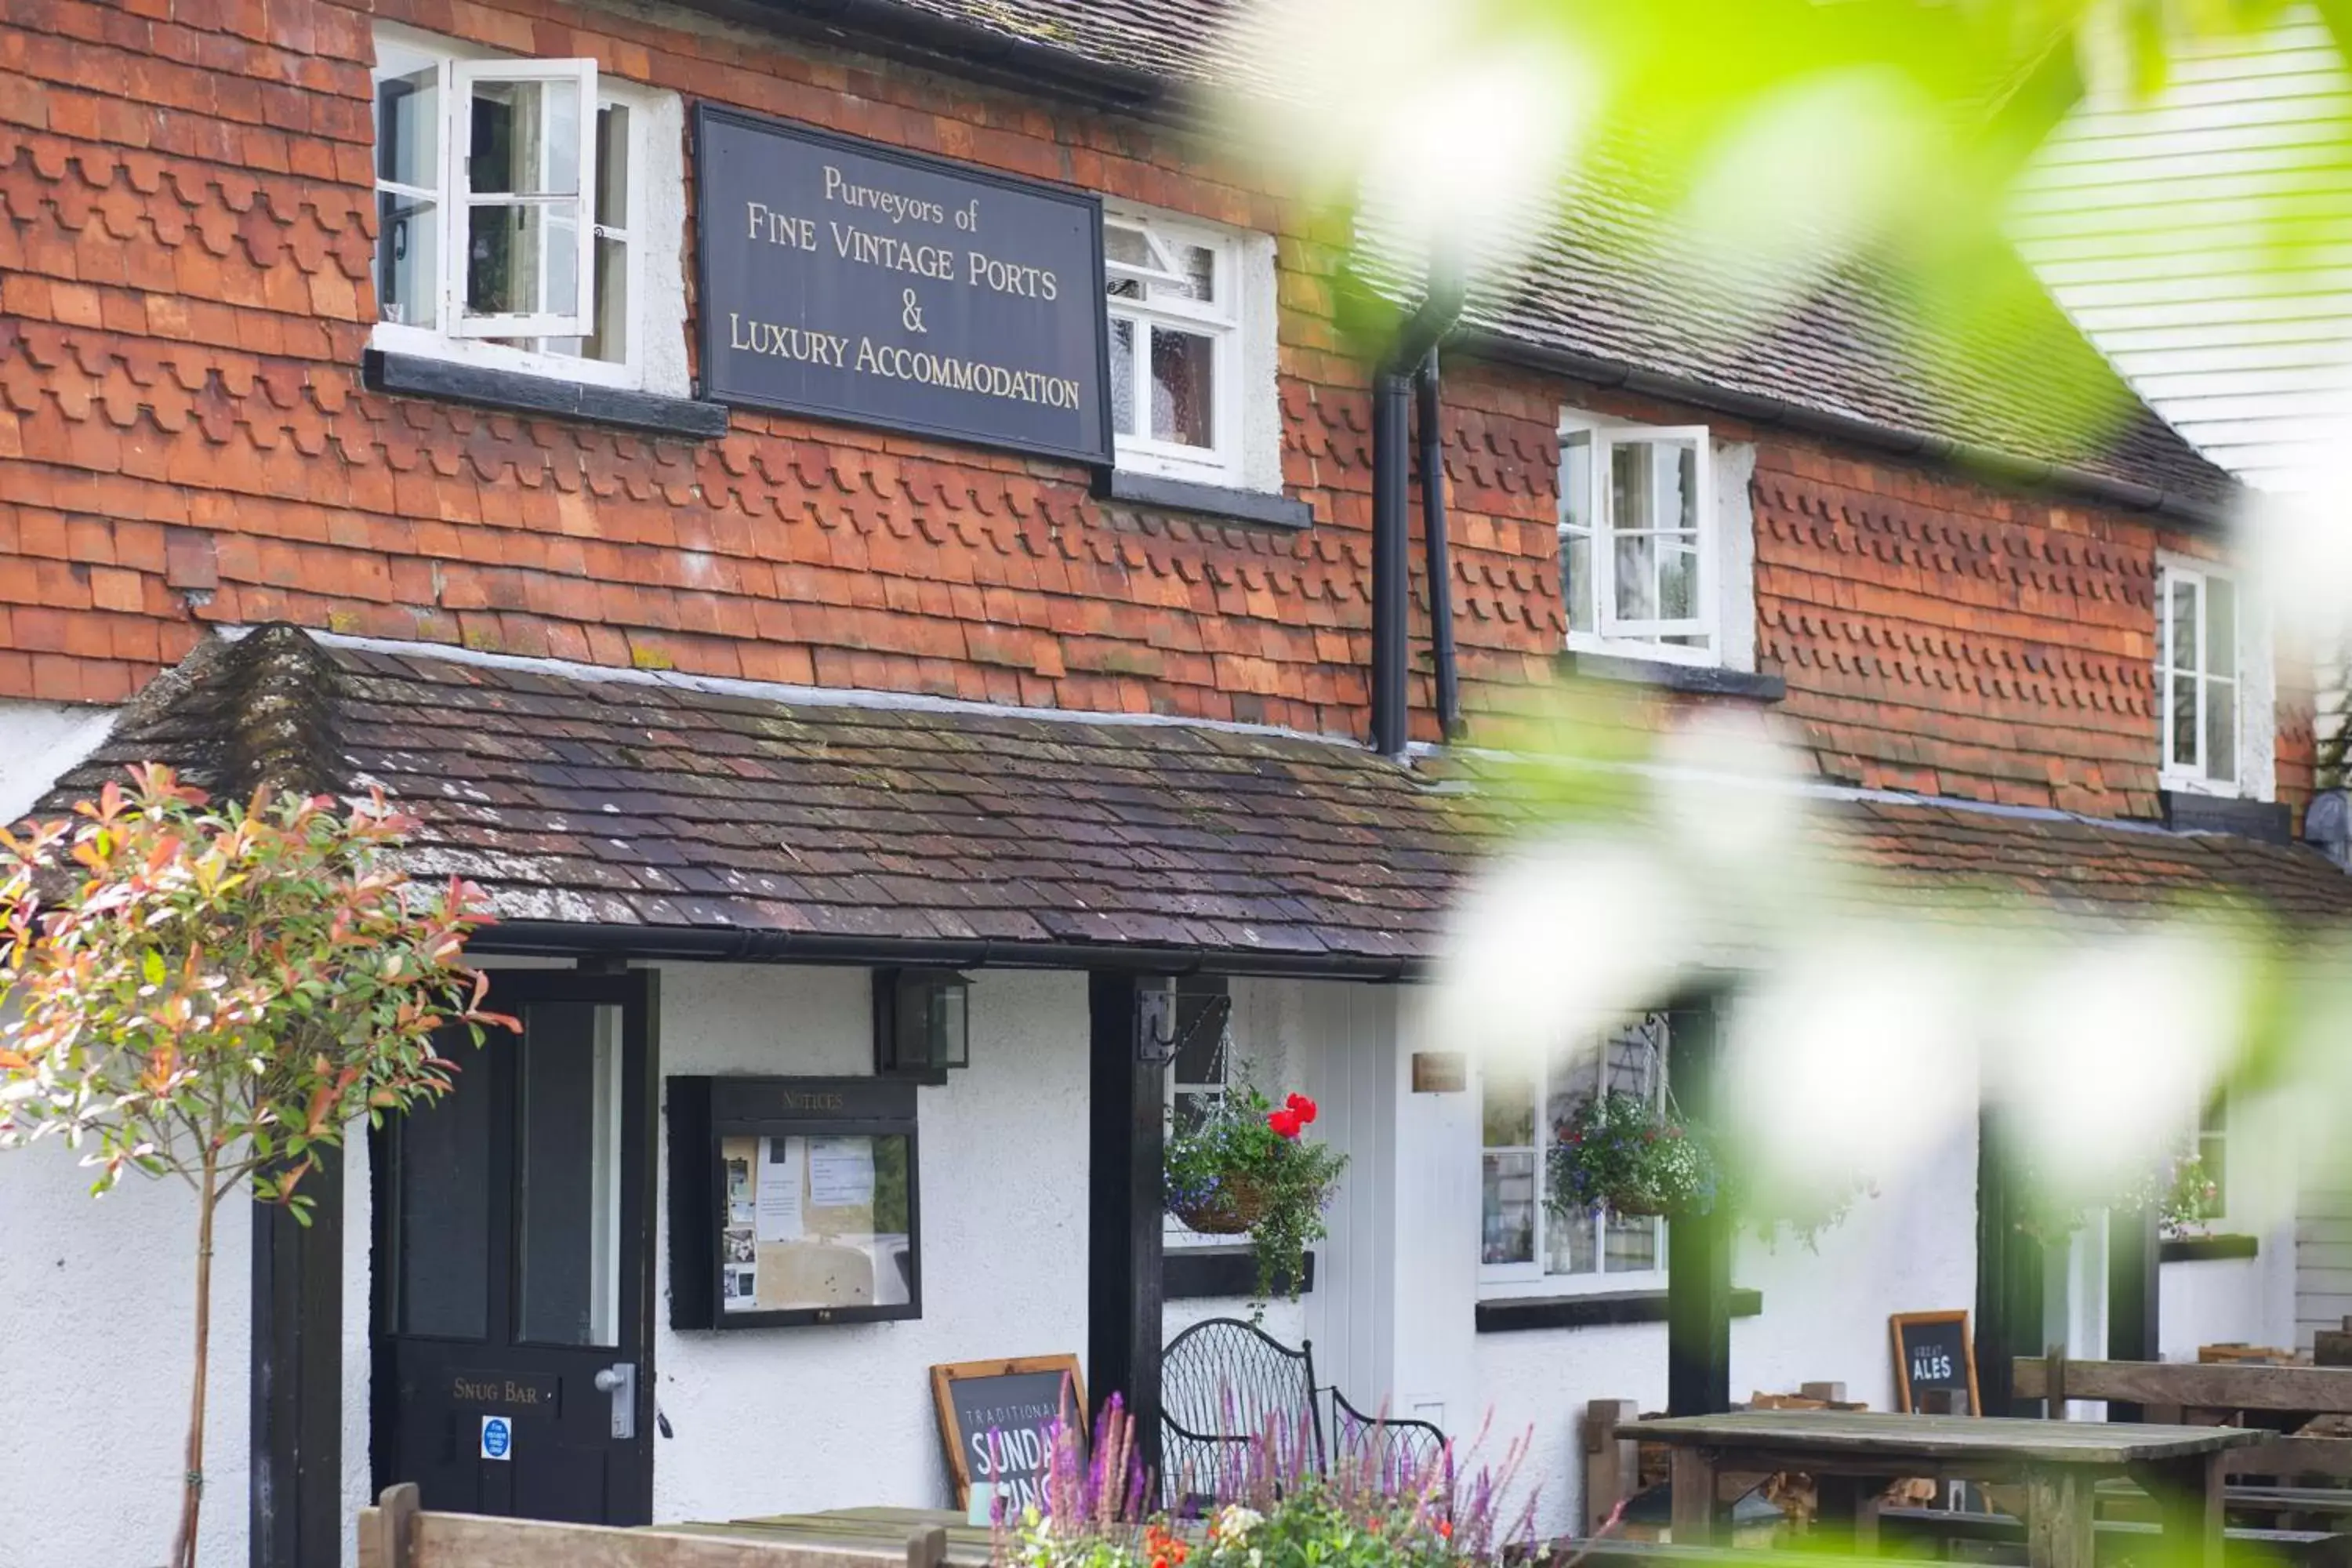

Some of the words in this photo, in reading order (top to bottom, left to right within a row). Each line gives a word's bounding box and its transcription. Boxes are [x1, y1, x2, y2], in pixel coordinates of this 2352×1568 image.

[823, 165, 943, 223] Purveyors
[955, 199, 979, 232] of
[747, 201, 817, 252] FINE
[829, 221, 954, 280] VINTAGE
[967, 251, 1057, 301] PORTS
[902, 288, 927, 333] &
[729, 313, 849, 368] LUXURY
[855, 336, 1080, 410] ACCOMMODATION
[782, 1089, 844, 1111] NOTICES
[454, 1377, 498, 1401] SNUG
[505, 1381, 539, 1404] BAR
[1914, 1355, 1951, 1381] ALES
[966, 1403, 1059, 1426] TRADITIONAL
[971, 1428, 1054, 1475] SUNDA
